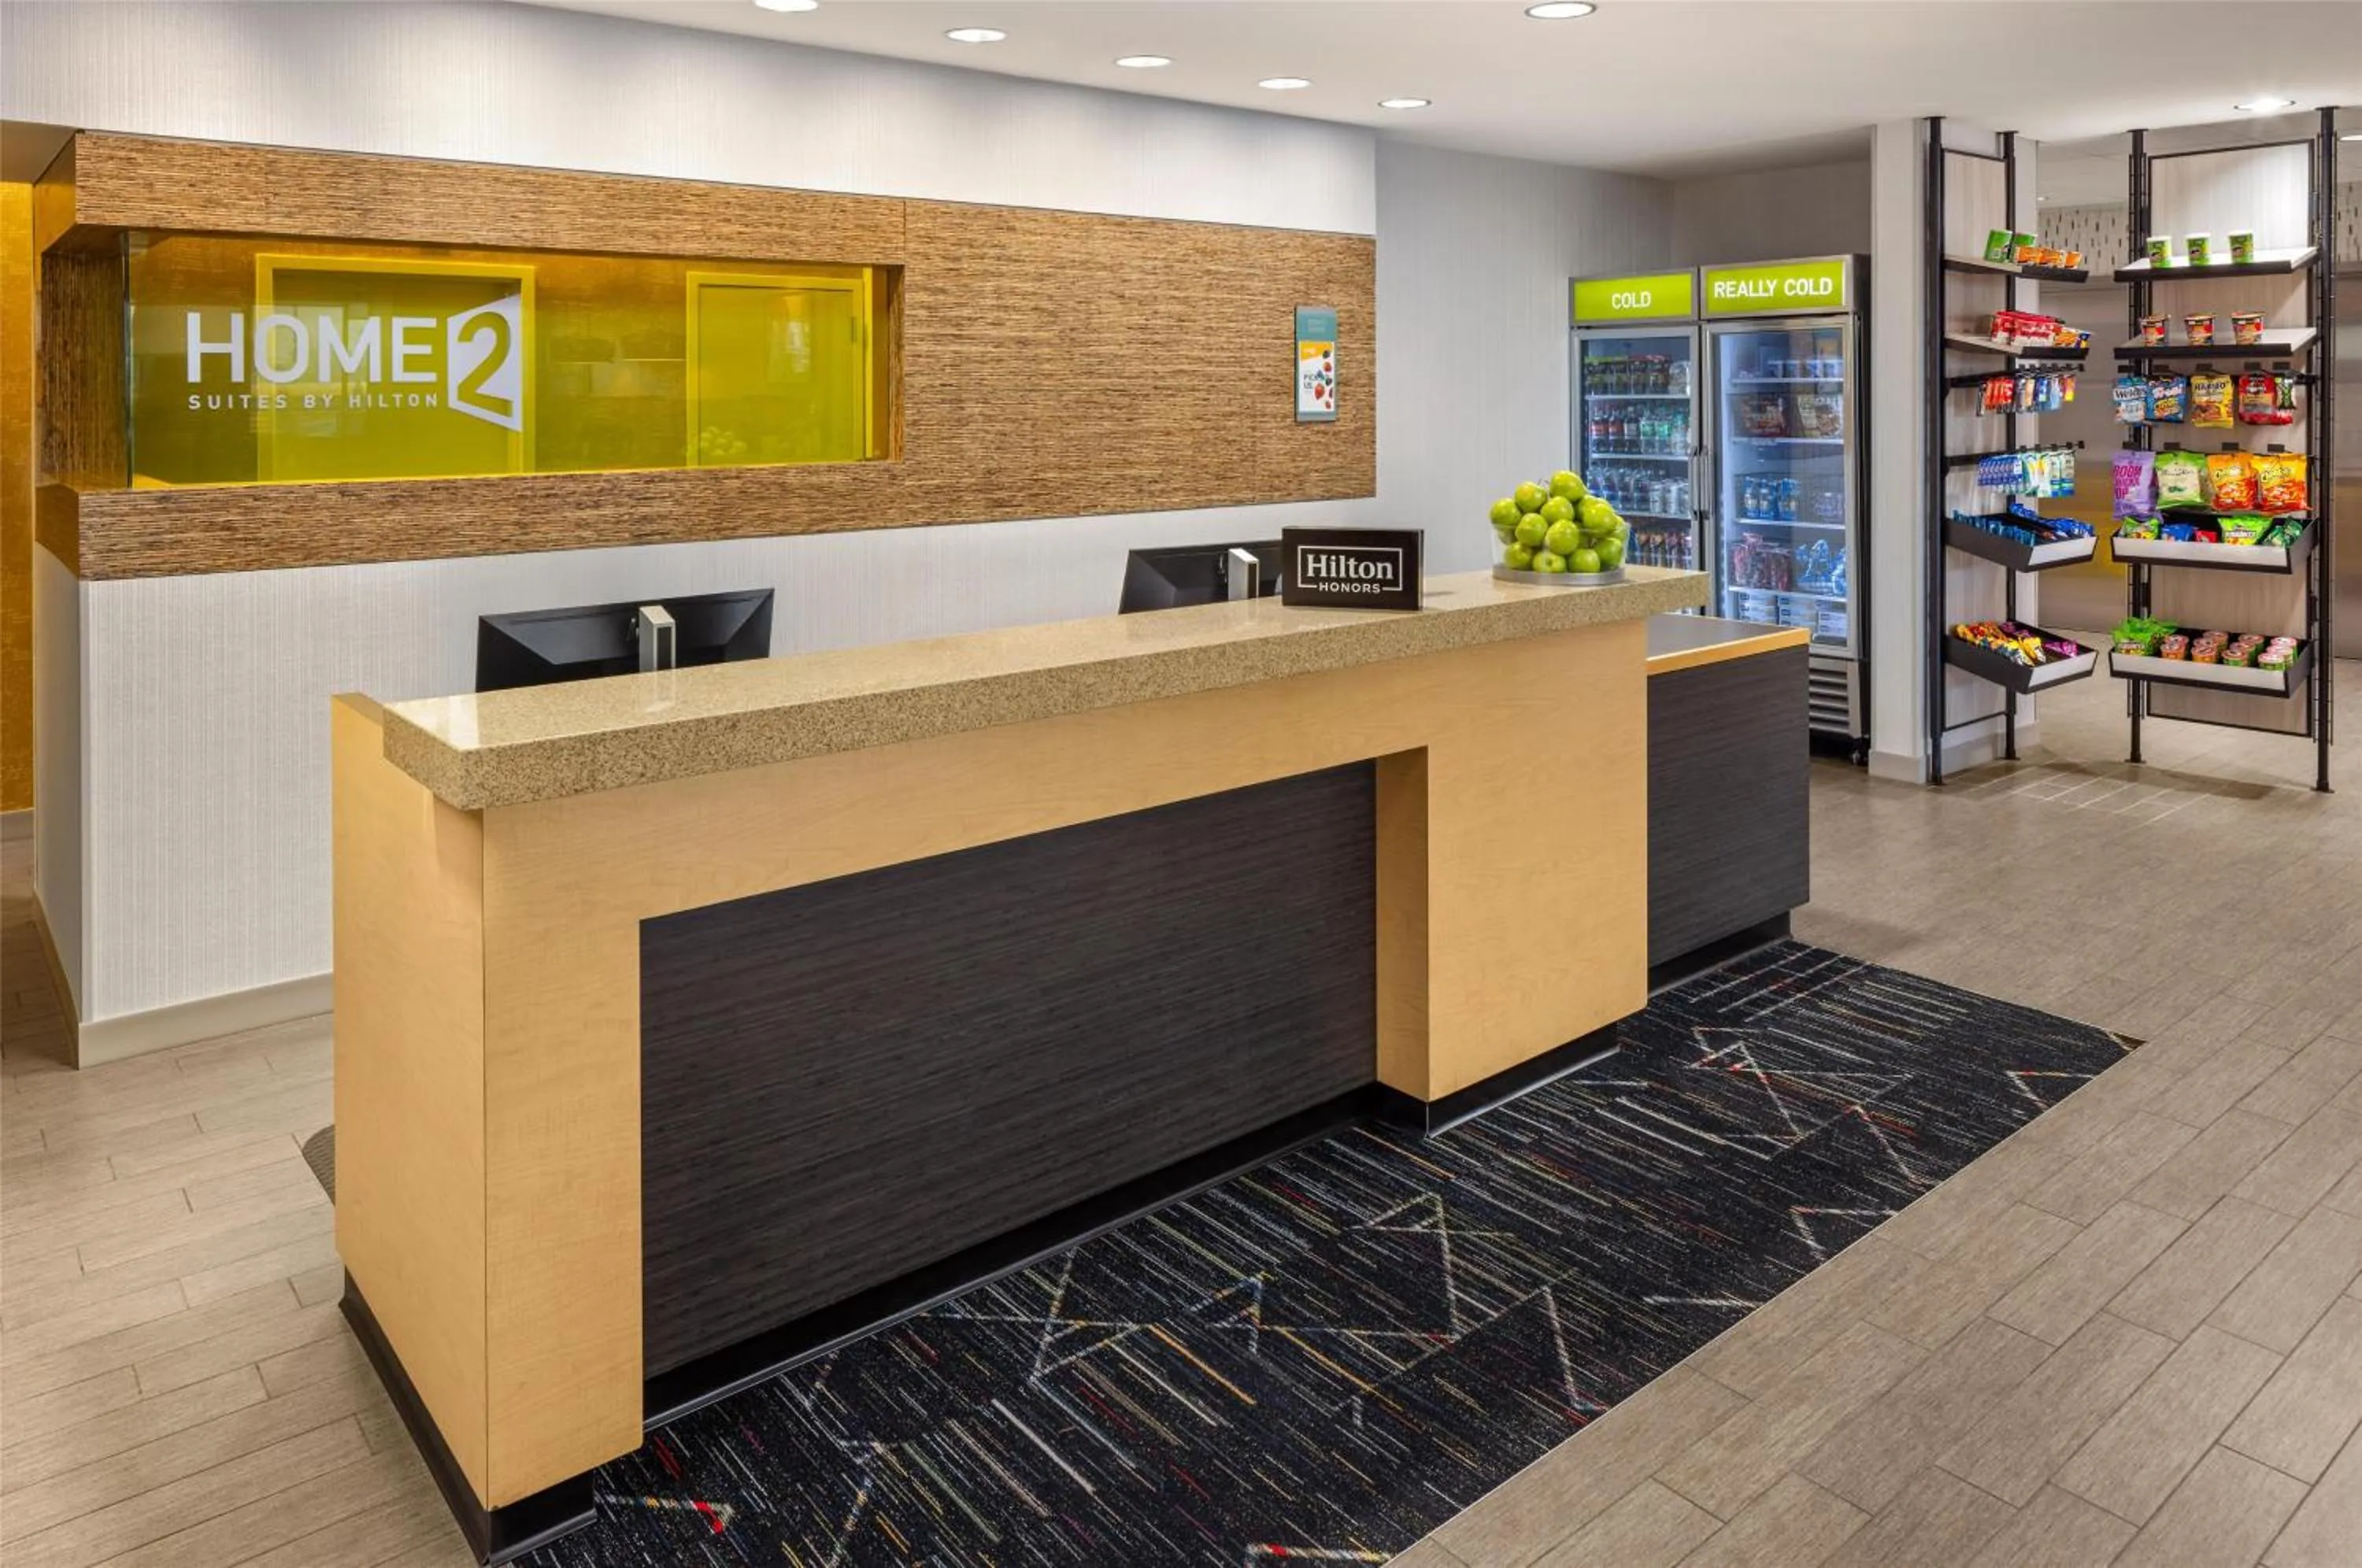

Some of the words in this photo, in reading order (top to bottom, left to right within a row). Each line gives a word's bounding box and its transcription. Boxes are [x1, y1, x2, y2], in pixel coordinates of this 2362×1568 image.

[1713, 279, 1778, 298] REALLY
[1783, 276, 1834, 297] COLD
[1612, 291, 1652, 309] COLD
[188, 394, 287, 409] SUITES
[303, 394, 331, 409] BY
[349, 393, 439, 408] HILTON
[1306, 553, 1394, 580] Hilton
[1319, 582, 1381, 594] HONORS
